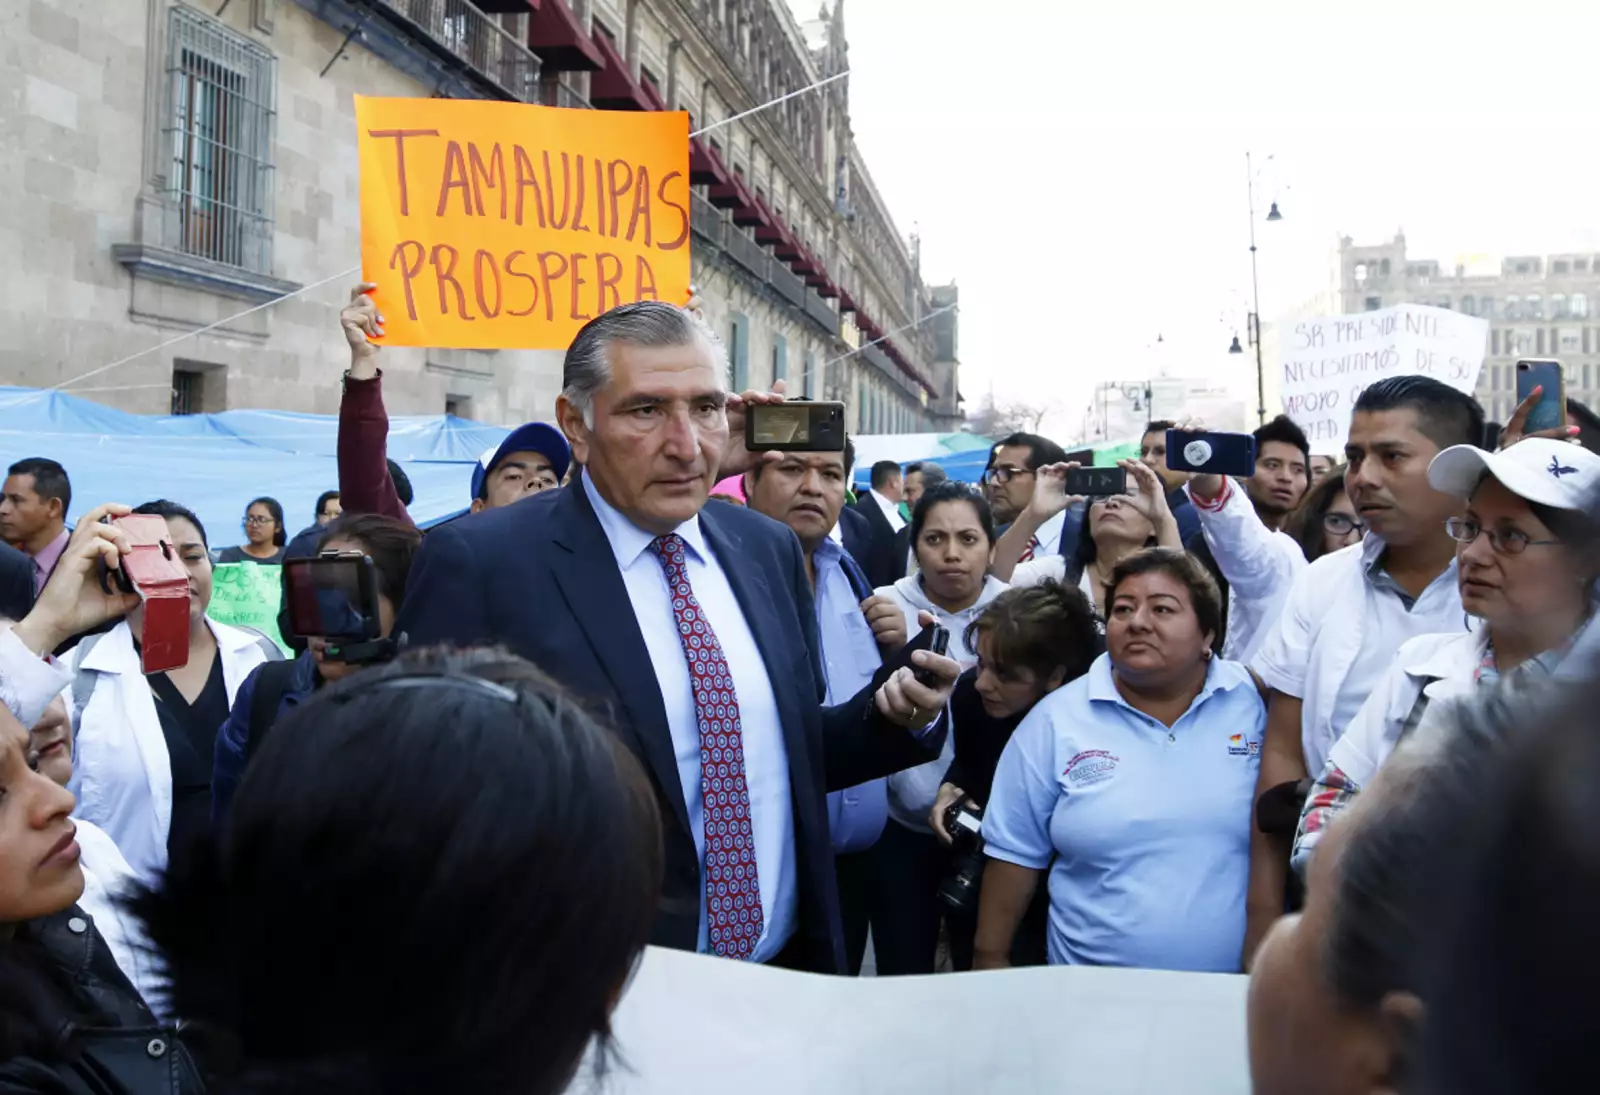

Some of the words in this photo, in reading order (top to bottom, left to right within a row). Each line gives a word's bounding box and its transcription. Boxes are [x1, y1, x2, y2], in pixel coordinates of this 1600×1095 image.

[368, 128, 689, 250] TAMAULIPAS
[389, 240, 659, 321] PROSPERA
[1333, 311, 1444, 343] PRESIDENTE
[1284, 344, 1400, 384] NECESITAMOS
[1416, 348, 1438, 373] DE
[1448, 356, 1471, 379] SU
[1286, 389, 1339, 415] APOYO
